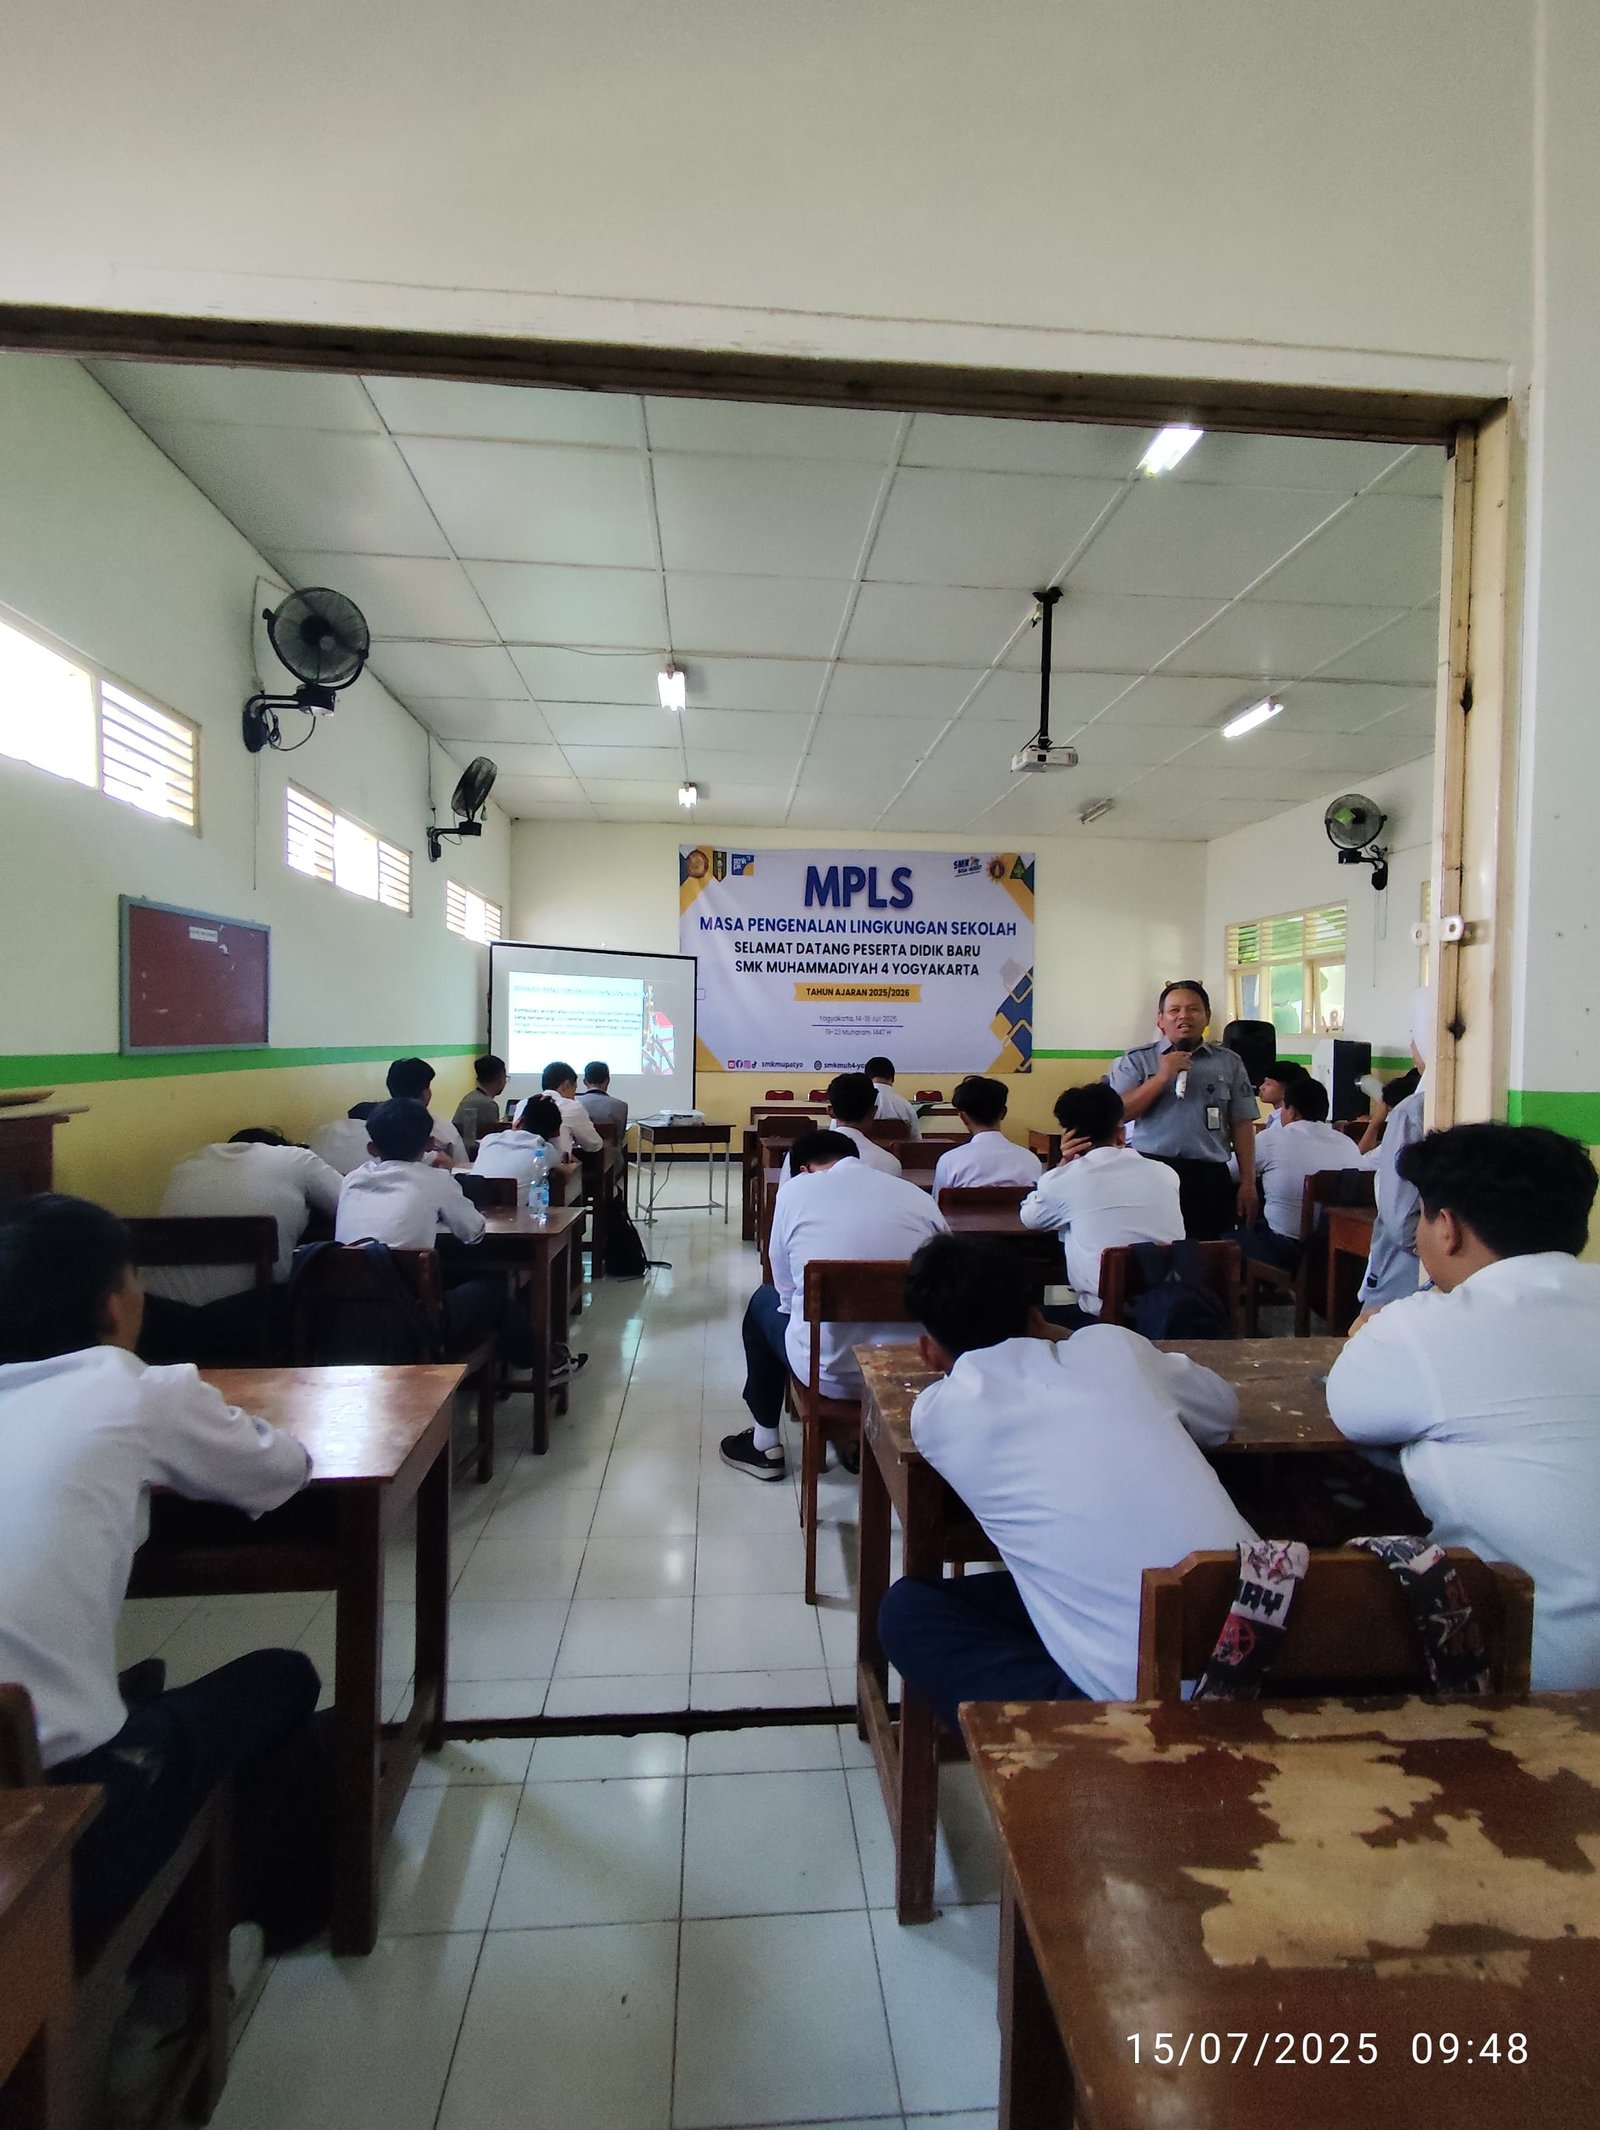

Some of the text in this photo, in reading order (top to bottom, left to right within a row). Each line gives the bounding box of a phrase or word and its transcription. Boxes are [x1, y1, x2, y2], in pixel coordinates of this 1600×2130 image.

[804, 866, 913, 909] MPLS
[699, 916, 1017, 936] MASA PENGENALAN LINGKUNGAN SEKOLAH
[734, 941, 981, 957] SELAMAT DATANG PESERTA DIDIK BARU
[735, 960, 979, 976] SMK MUHAMMADIYAH 4 YOGYAKARTA
[806, 987, 910, 998] TAHUN AJARAN 2025/2026
